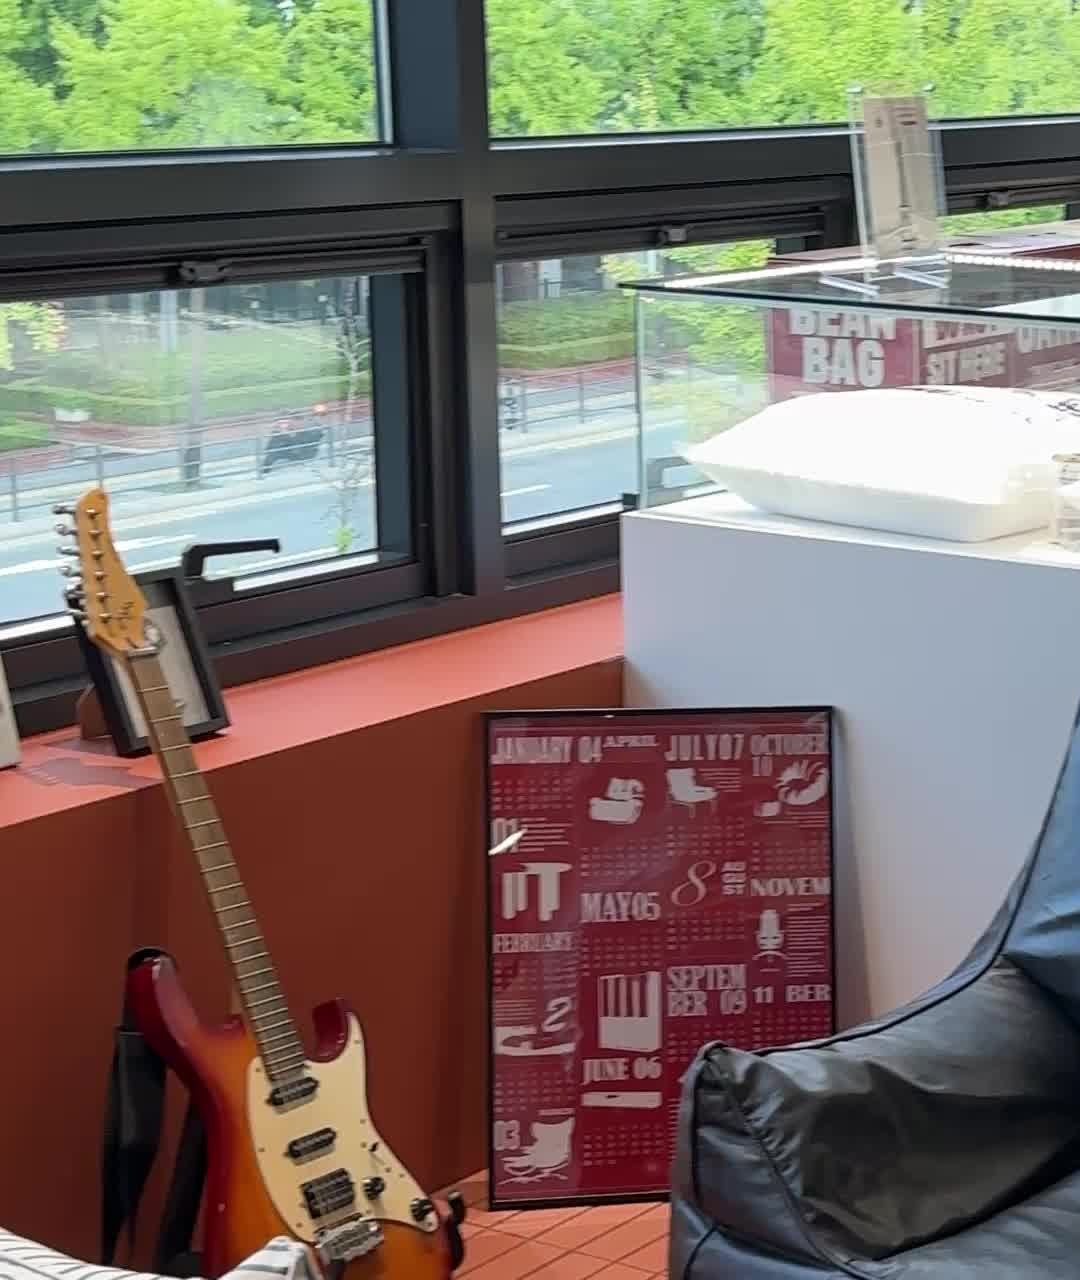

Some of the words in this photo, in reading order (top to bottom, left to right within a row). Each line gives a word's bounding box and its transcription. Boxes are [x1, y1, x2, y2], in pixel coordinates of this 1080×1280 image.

[789, 309, 897, 340] BEAN
[802, 337, 885, 387] BAG
[926, 350, 957, 385] SIT
[491, 736, 572, 764] JANUARY
[603, 735, 659, 747] APRIL
[751, 733, 829, 756] OCTOBER
[671, 860, 716, 906] 8
[493, 931, 574, 953] FEBRUARY
[667, 964, 747, 991] SEPTEM
[668, 990, 707, 1017] BER
[786, 984, 832, 1002] BER
[580, 1057, 630, 1086] JUNE
[633, 1056, 662, 1080] 06
